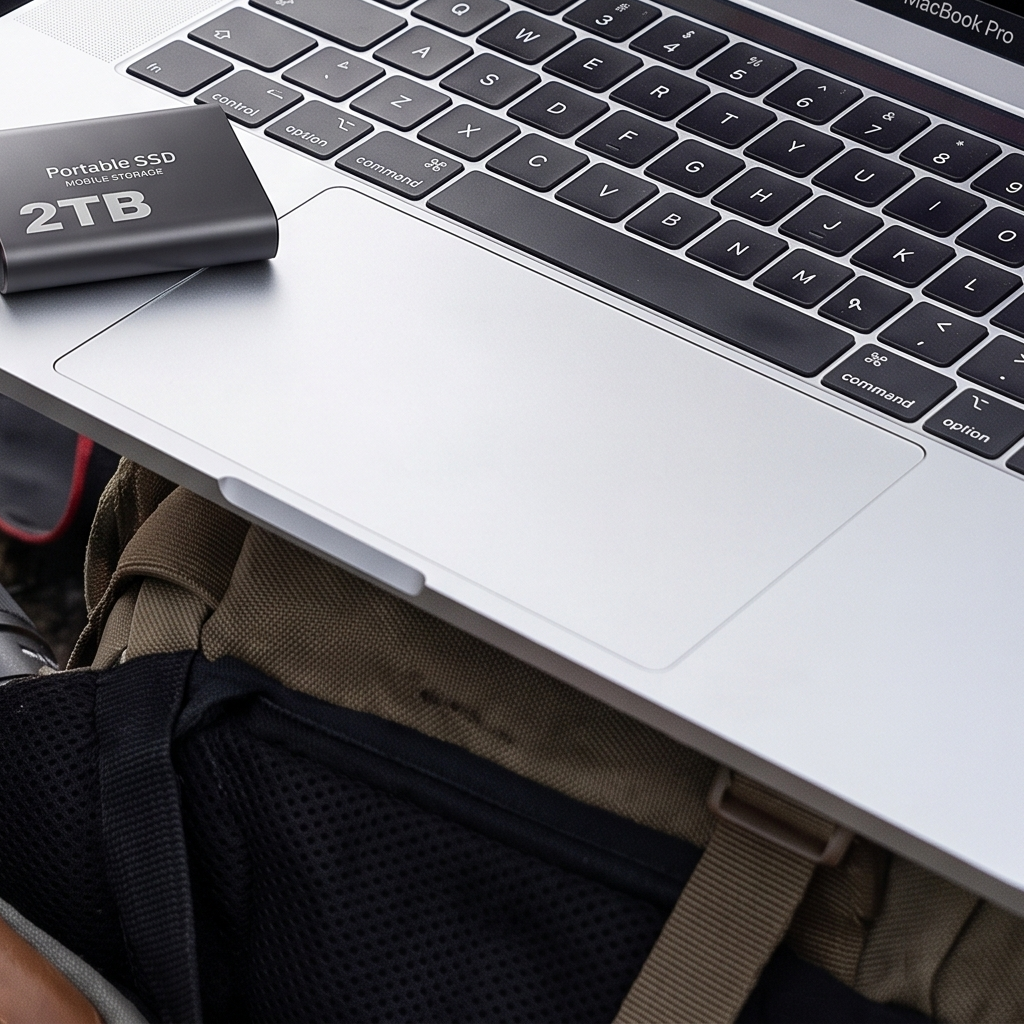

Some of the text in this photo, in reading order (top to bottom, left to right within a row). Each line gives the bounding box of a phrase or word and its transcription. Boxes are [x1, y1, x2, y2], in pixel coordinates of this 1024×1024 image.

[451, 3, 470, 17] Q
[595, 14, 614, 26] 3
[515, 27, 541, 43] W
[984, 20, 1014, 44] Pro
[411, 46, 431, 59] A
[663, 43, 681, 53] 4
[582, 57, 604, 71] E
[479, 73, 500, 86] S
[729, 69, 747, 80] 5
[649, 85, 670, 99] R
[212, 93, 260, 117] control
[390, 94, 413, 109] Z
[546, 101, 567, 114] D
[796, 97, 814, 108] 6
[720, 112, 739, 124] T
[457, 123, 481, 138] X
[618, 130, 639, 141] F
[864, 124, 883, 134] 7
[284, 125, 328, 147] option
[788, 140, 806, 153] Y
[528, 154, 548, 167] C
[932, 152, 951, 164] 8
[45, 151, 176, 179] Portable SSD
[685, 160, 705, 173] G
[65, 168, 164, 188] MOBILE STORAGE
[854, 169, 875, 182] U
[599, 184, 619, 197] V
[1005, 181, 1023, 194] 9
[749, 188, 773, 203] H
[19, 189, 152, 235] 2TB
[661, 213, 682, 226] B
[823, 220, 842, 230] J
[997, 229, 1017, 242] O
[726, 241, 750, 256] N
[892, 248, 915, 263] K
[791, 269, 817, 285] M
[964, 278, 977, 292] L
[841, 373, 916, 409] command
[942, 418, 990, 443] option
